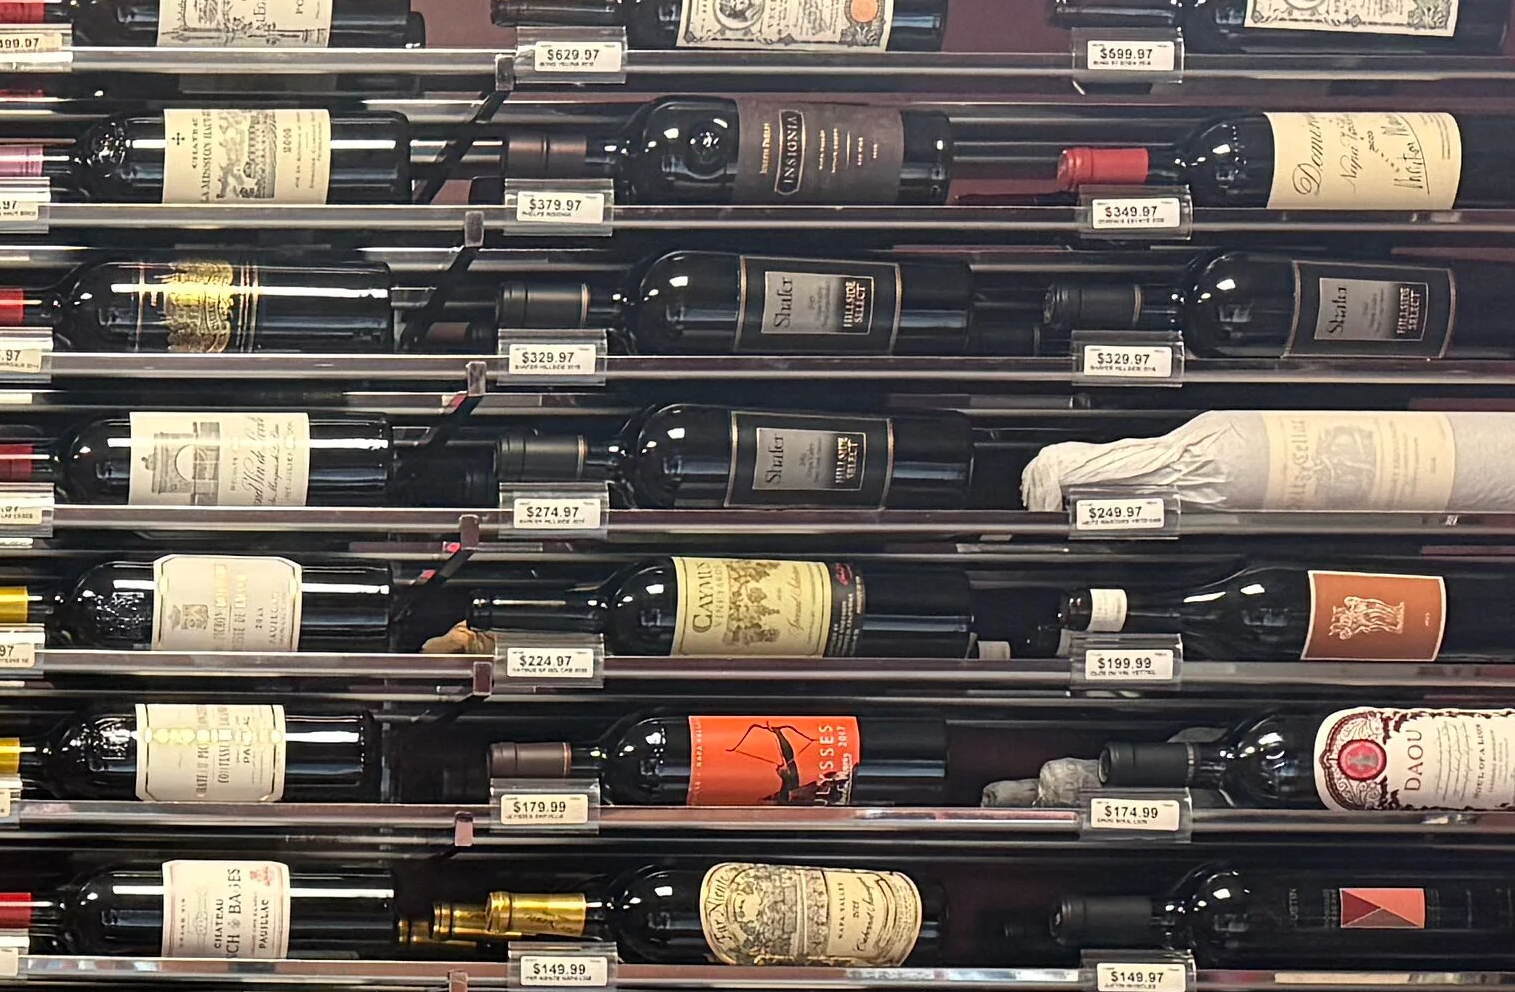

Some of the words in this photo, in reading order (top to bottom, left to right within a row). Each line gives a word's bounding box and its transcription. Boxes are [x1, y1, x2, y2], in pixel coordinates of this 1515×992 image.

[784, 117, 798, 183] INSIGNIA
[529, 198, 582, 212] $379.97
[1104, 205, 1158, 218] $349.97
[774, 277, 792, 328] Shafer
[843, 281, 855, 327] HILLSIDE
[854, 282, 865, 323] SELECT
[1408, 290, 1420, 330] SELECT
[521, 351, 574, 364] $329.97
[1097, 352, 1150, 365] $329.97
[765, 434, 783, 484] Shafer
[835, 437, 848, 483] HILLSIDE
[846, 439, 858, 479] SELECT
[526, 506, 579, 518] $274.97
[1088, 506, 1142, 519] $249.97
[692, 561, 714, 633] CAYMUS
[519, 655, 572, 667] $224.97
[1097, 657, 1152, 669] $199.99
[838, 725, 848, 747] 2017
[1404, 729, 1424, 791] DAOU
[513, 801, 566, 813] $179.99
[1104, 805, 1158, 819] $174.99
[214, 898, 223, 949] CHATEAU
[259, 900, 269, 949] PAUILLAC
[533, 963, 586, 975] $149.99
[1110, 970, 1164, 983] $149.97
